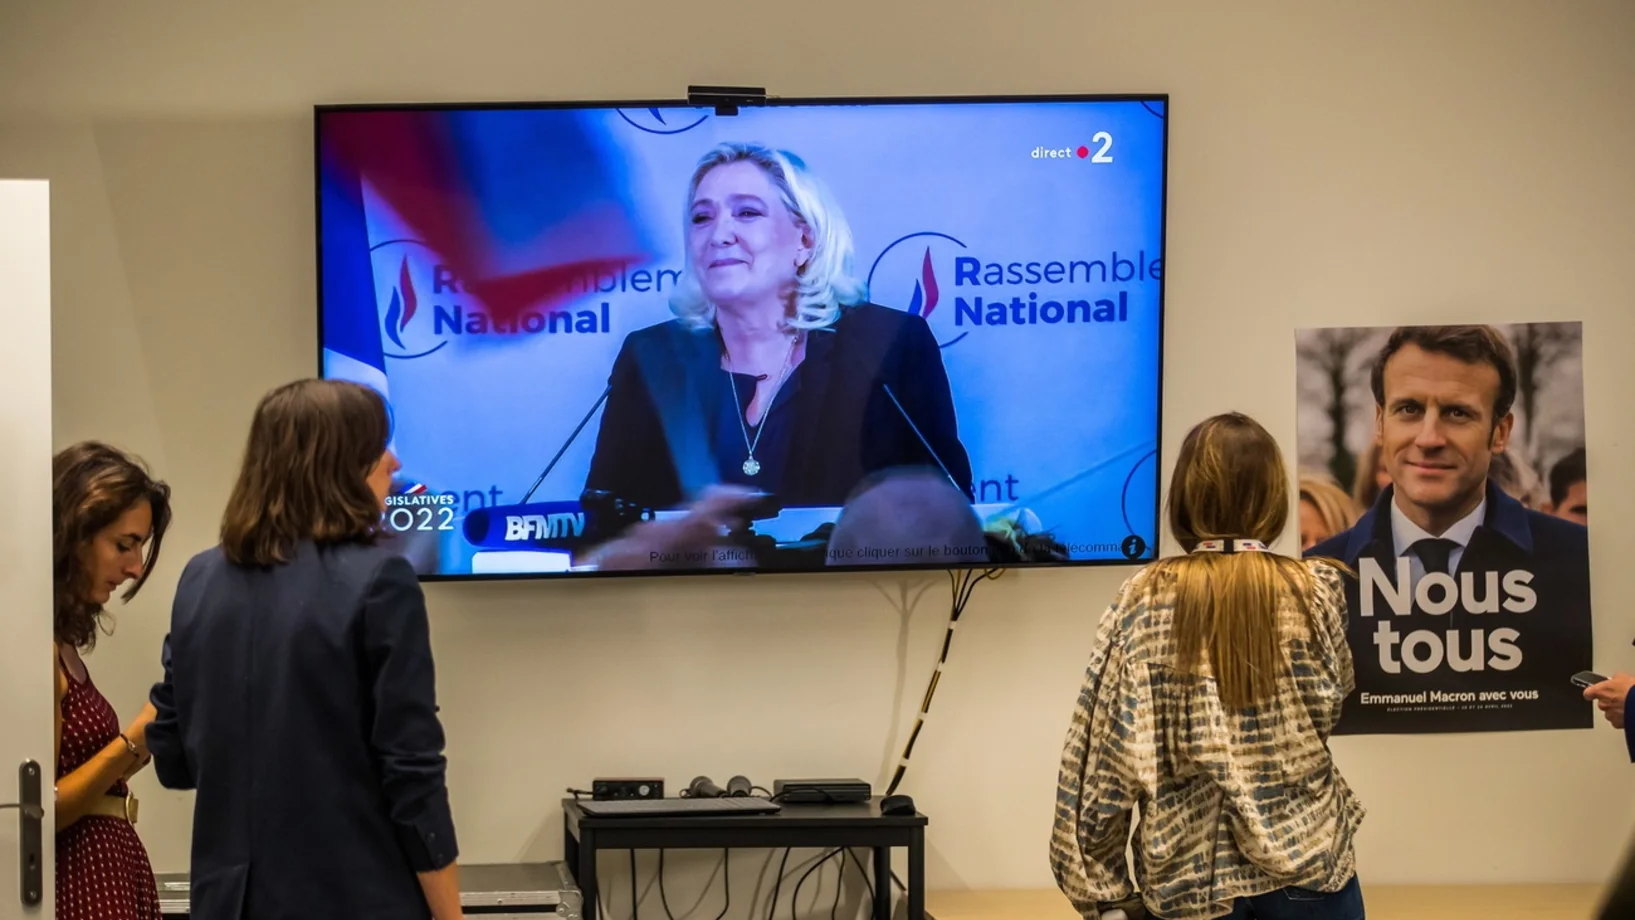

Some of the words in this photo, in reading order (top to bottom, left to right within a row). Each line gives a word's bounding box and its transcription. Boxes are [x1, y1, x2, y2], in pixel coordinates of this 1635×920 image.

[1030, 146, 1072, 159] direct
[1090, 131, 1114, 163] 2
[954, 291, 1128, 326] National
[384, 494, 454, 506] GISLATIVES
[972, 474, 1019, 501] nt
[382, 507, 454, 531] 022
[504, 512, 585, 541] BFMTV
[650, 551, 679, 563] Pour
[685, 551, 709, 563] voir
[712, 549, 755, 561] l'affich
[857, 546, 900, 561] cliquer
[904, 546, 925, 558] sur
[929, 544, 940, 558] le
[944, 544, 988, 557] bouton
[1358, 556, 1538, 617] Nous
[1373, 620, 1523, 674] tous
[1360, 690, 1427, 705] Emmanuel
[1429, 690, 1476, 703] Macron
[1478, 691, 1507, 702] avec
[1509, 689, 1539, 700] vous
